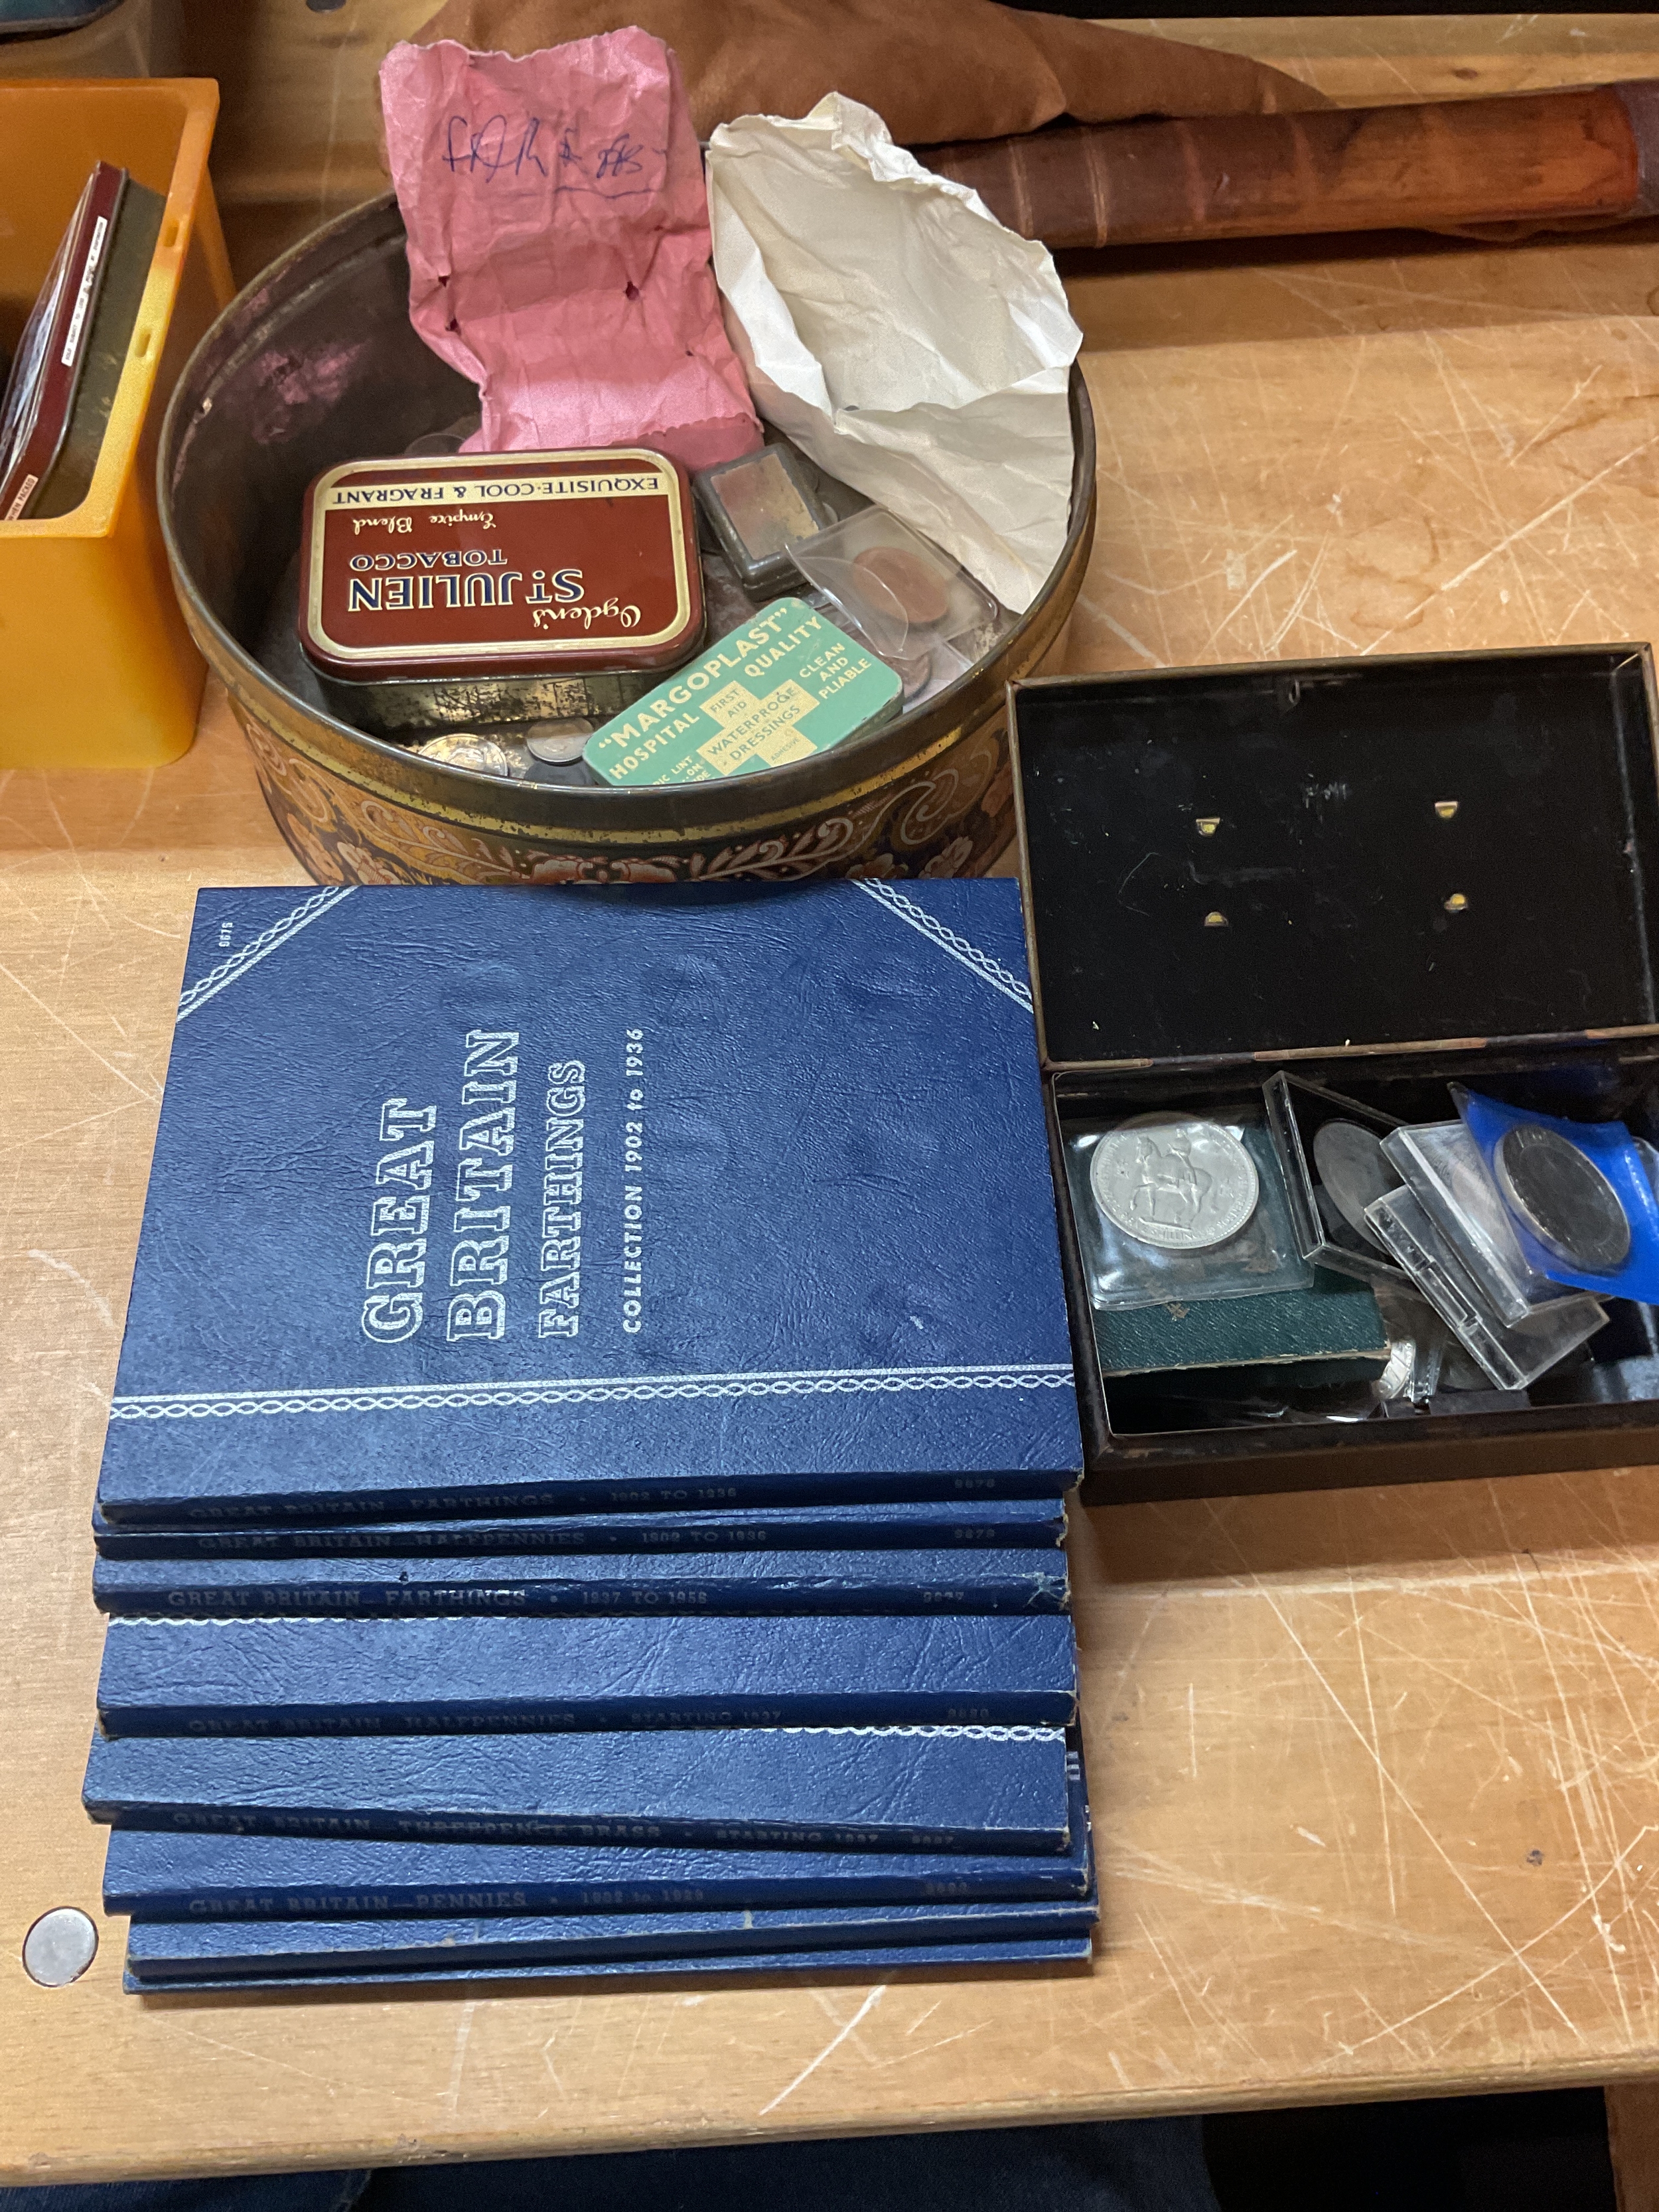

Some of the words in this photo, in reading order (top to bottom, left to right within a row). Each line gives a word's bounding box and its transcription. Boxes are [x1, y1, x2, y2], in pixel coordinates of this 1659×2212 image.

[333, 486, 445, 504] FRAGRANT
[454, 484, 466, 499] &
[352, 516, 413, 535] Blend
[429, 508, 496, 530] Empire
[349, 548, 508, 571] TOBACCO
[347, 571, 524, 613] JULIEN
[799, 642, 847, 678] CLEAN
[818, 656, 850, 682] AND
[818, 658, 873, 700] PLIABLE
[609, 711, 700, 780] HOSPITAL
[744, 616, 824, 678] QUALITY
[710, 688, 740, 713] FIRST
[727, 701, 747, 718] AID
[729, 705, 800, 761] DRESSINGS
[770, 738, 800, 761] ADHESIVE
[670, 755, 693, 774] LINT
[626, 1028, 644, 1076] 1936
[626, 1089, 644, 1111] to
[624, 1121, 644, 1172] 1902
[447, 1029, 520, 1342] BRITAIN
[538, 1060, 587, 1338] FARTHINGS
[361, 1098, 437, 1343] GREAT
[622, 1185, 643, 1333] COLLECTION
[409, 1493, 553, 1509] FARTHINGS
[660, 1489, 688, 1500] TO
[293, 1534, 391, 1548] BRITAIN
[691, 1530, 719, 1542] TO
[168, 1590, 250, 1607] GREAT
[266, 1590, 360, 1606] BRITAIN
[386, 1589, 526, 1606] FARTHINGS
[583, 1591, 621, 1605] 1937
[632, 1591, 660, 1605] TO
[188, 1897, 274, 1913] GREAT
[288, 1895, 390, 1911] BRITAIN
[416, 1891, 529, 1909] PENNIES
